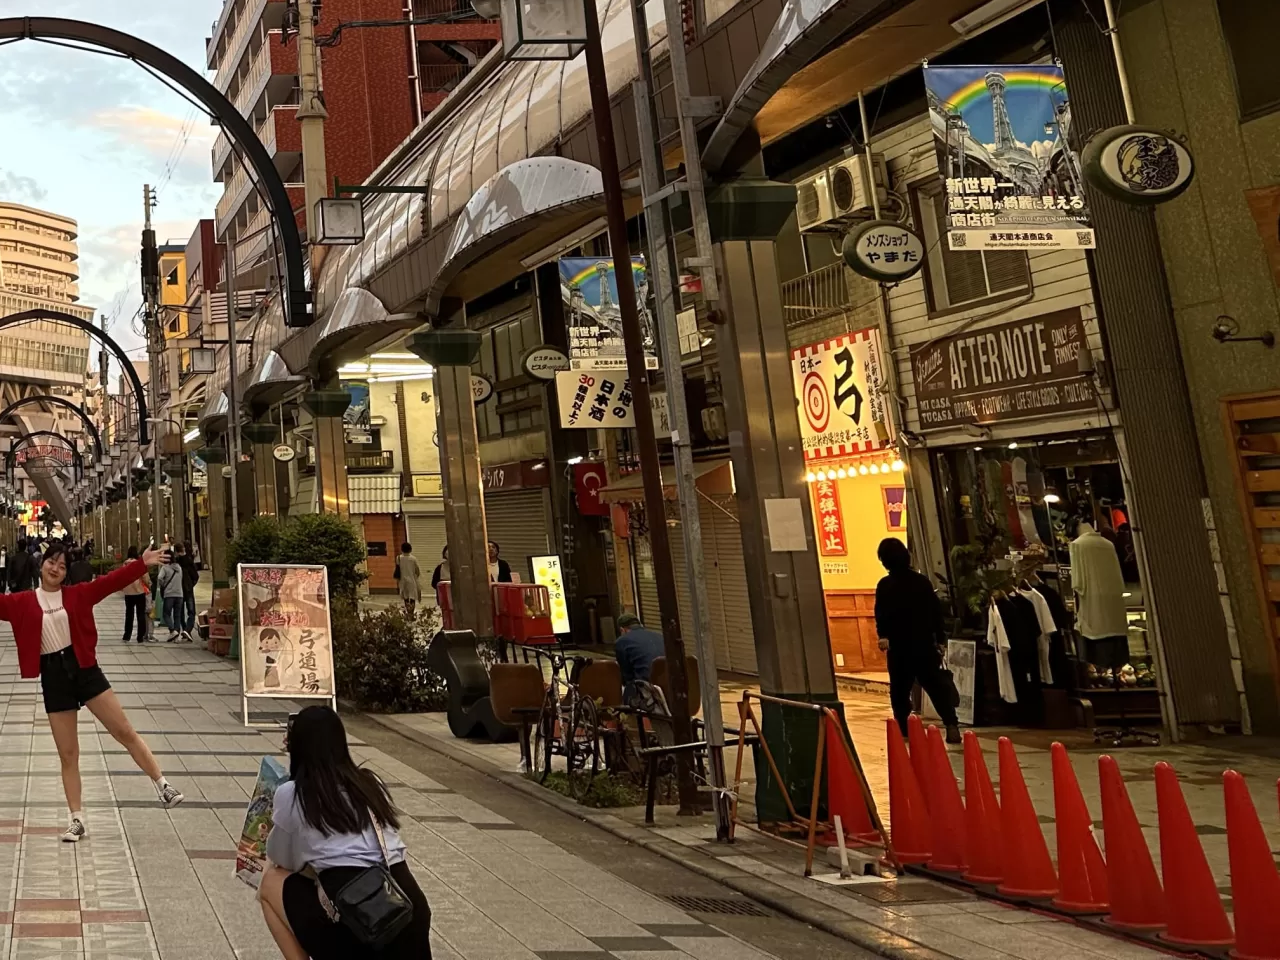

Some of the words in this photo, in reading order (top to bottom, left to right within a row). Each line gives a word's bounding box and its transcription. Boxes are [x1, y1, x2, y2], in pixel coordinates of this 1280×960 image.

[946, 177, 1014, 194] 新世界一
[950, 196, 1084, 211] 通天閣が綺麗に見える
[951, 213, 996, 227] 商店街
[866, 233, 908, 247] メンズショップ
[866, 251, 918, 264] やまだ
[569, 326, 611, 337] 新世界一
[1052, 325, 1067, 346] ONLY
[800, 356, 822, 373] 日本一
[833, 346, 863, 426] 弓
[588, 379, 615, 422] 日本酒
[931, 397, 951, 409] CASA
[817, 480, 842, 551] 実弾禁止
[547, 561, 558, 569] 3F
[298, 629, 321, 693] 弓道場
